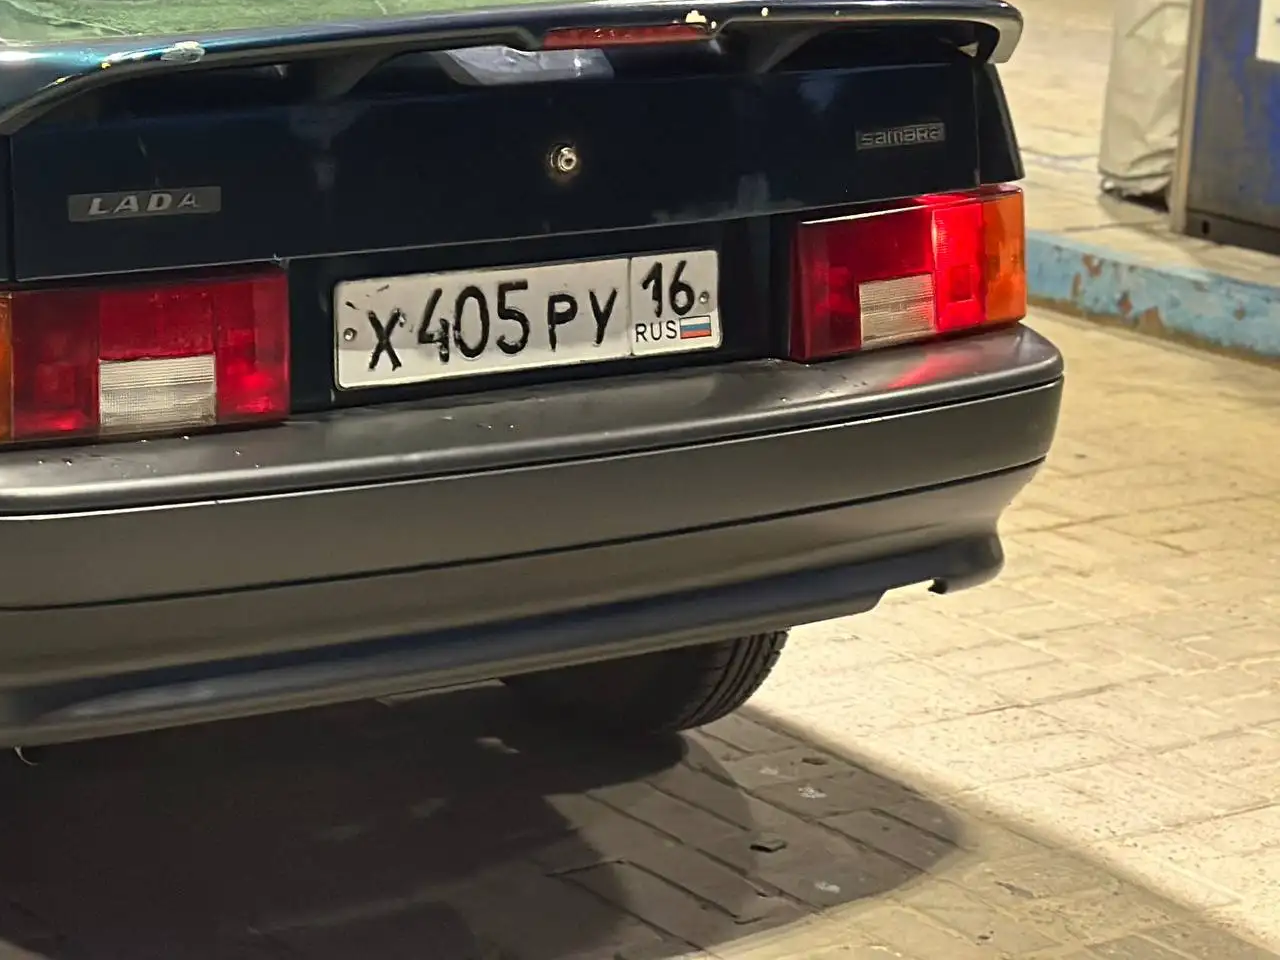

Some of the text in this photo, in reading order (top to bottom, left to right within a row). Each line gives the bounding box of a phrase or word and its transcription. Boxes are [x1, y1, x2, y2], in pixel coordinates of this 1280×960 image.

[88, 192, 201, 216] LADA
[641, 259, 697, 318] 16
[634, 319, 678, 343] RUS
